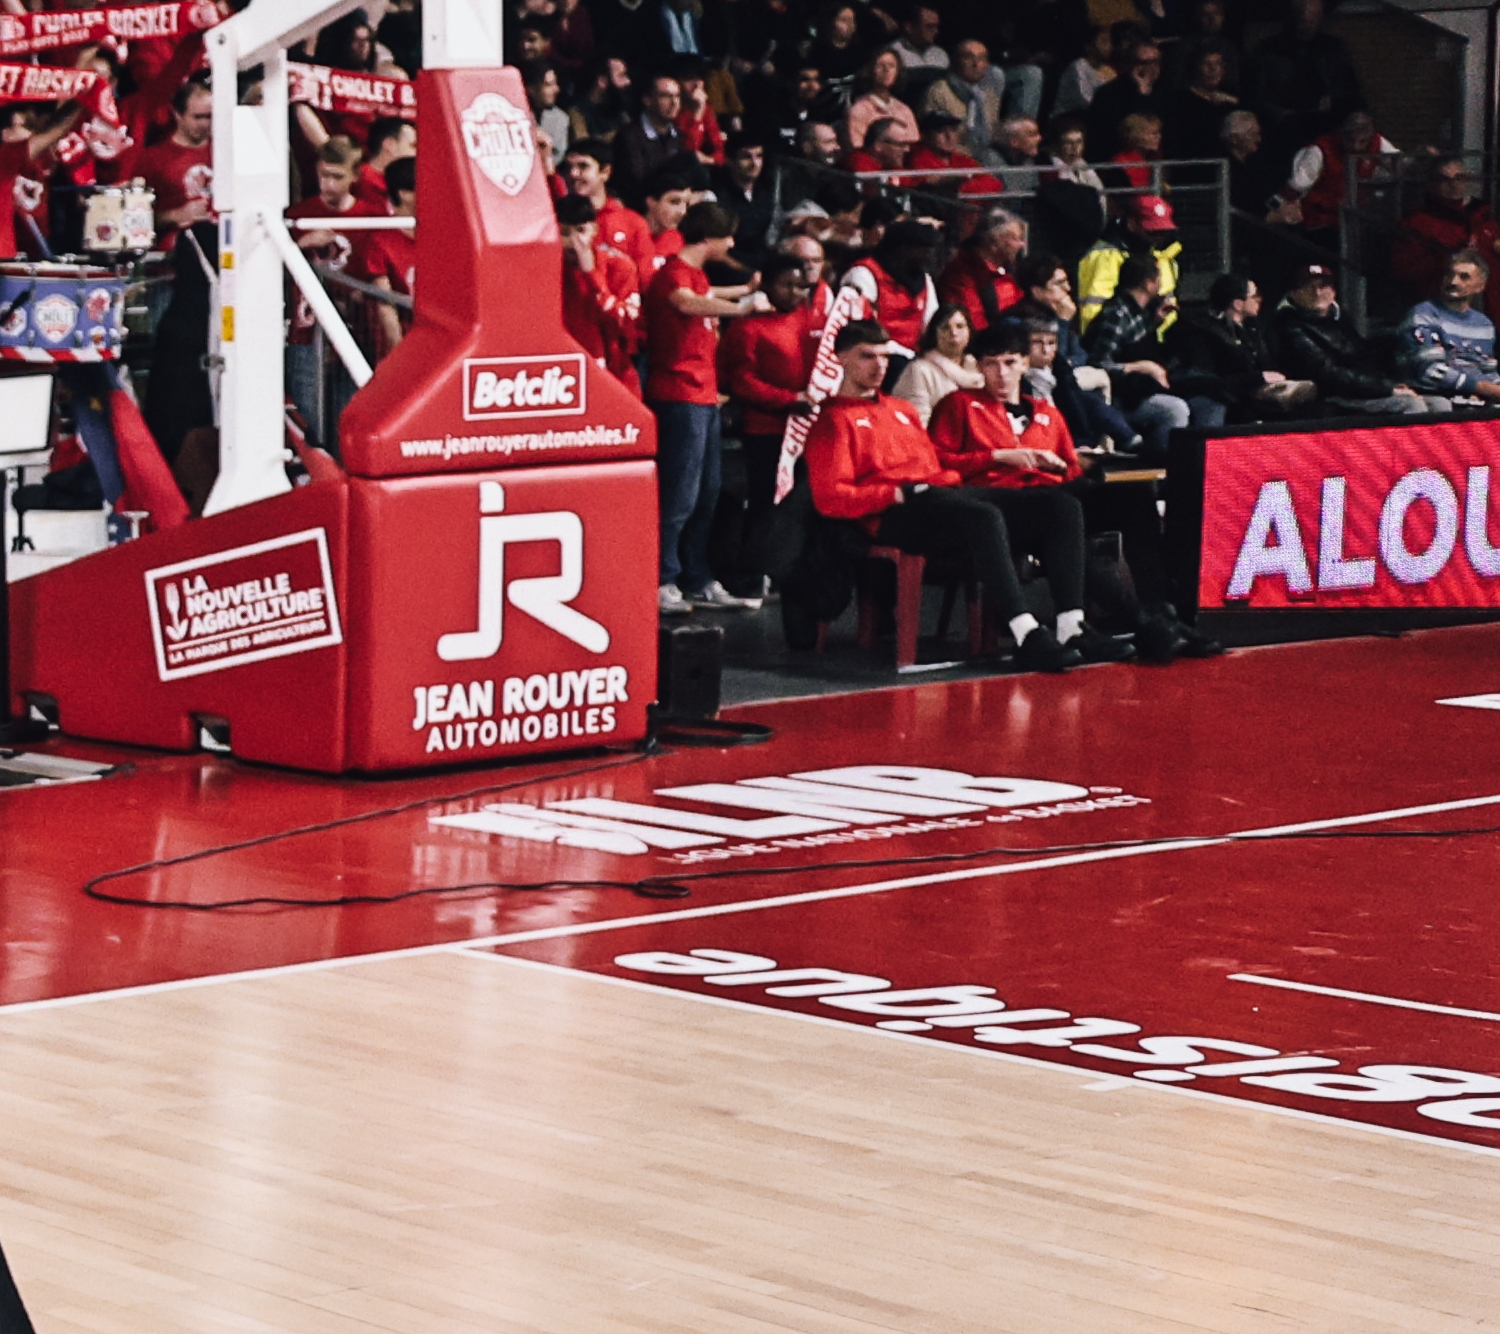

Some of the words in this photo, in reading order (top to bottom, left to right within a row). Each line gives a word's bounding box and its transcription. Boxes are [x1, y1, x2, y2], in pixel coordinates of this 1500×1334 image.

[472, 365, 577, 409] Betclic
[400, 423, 640, 461] www.jeanrouyerautomobiles.fr
[181, 574, 209, 596] LA
[185, 572, 292, 617] NOUVELLE
[190, 587, 324, 638] AGRICULTURE
[413, 679, 494, 730] JEAN
[503, 666, 629, 714] ROUYER
[425, 707, 616, 754] AUTOMOBILES
